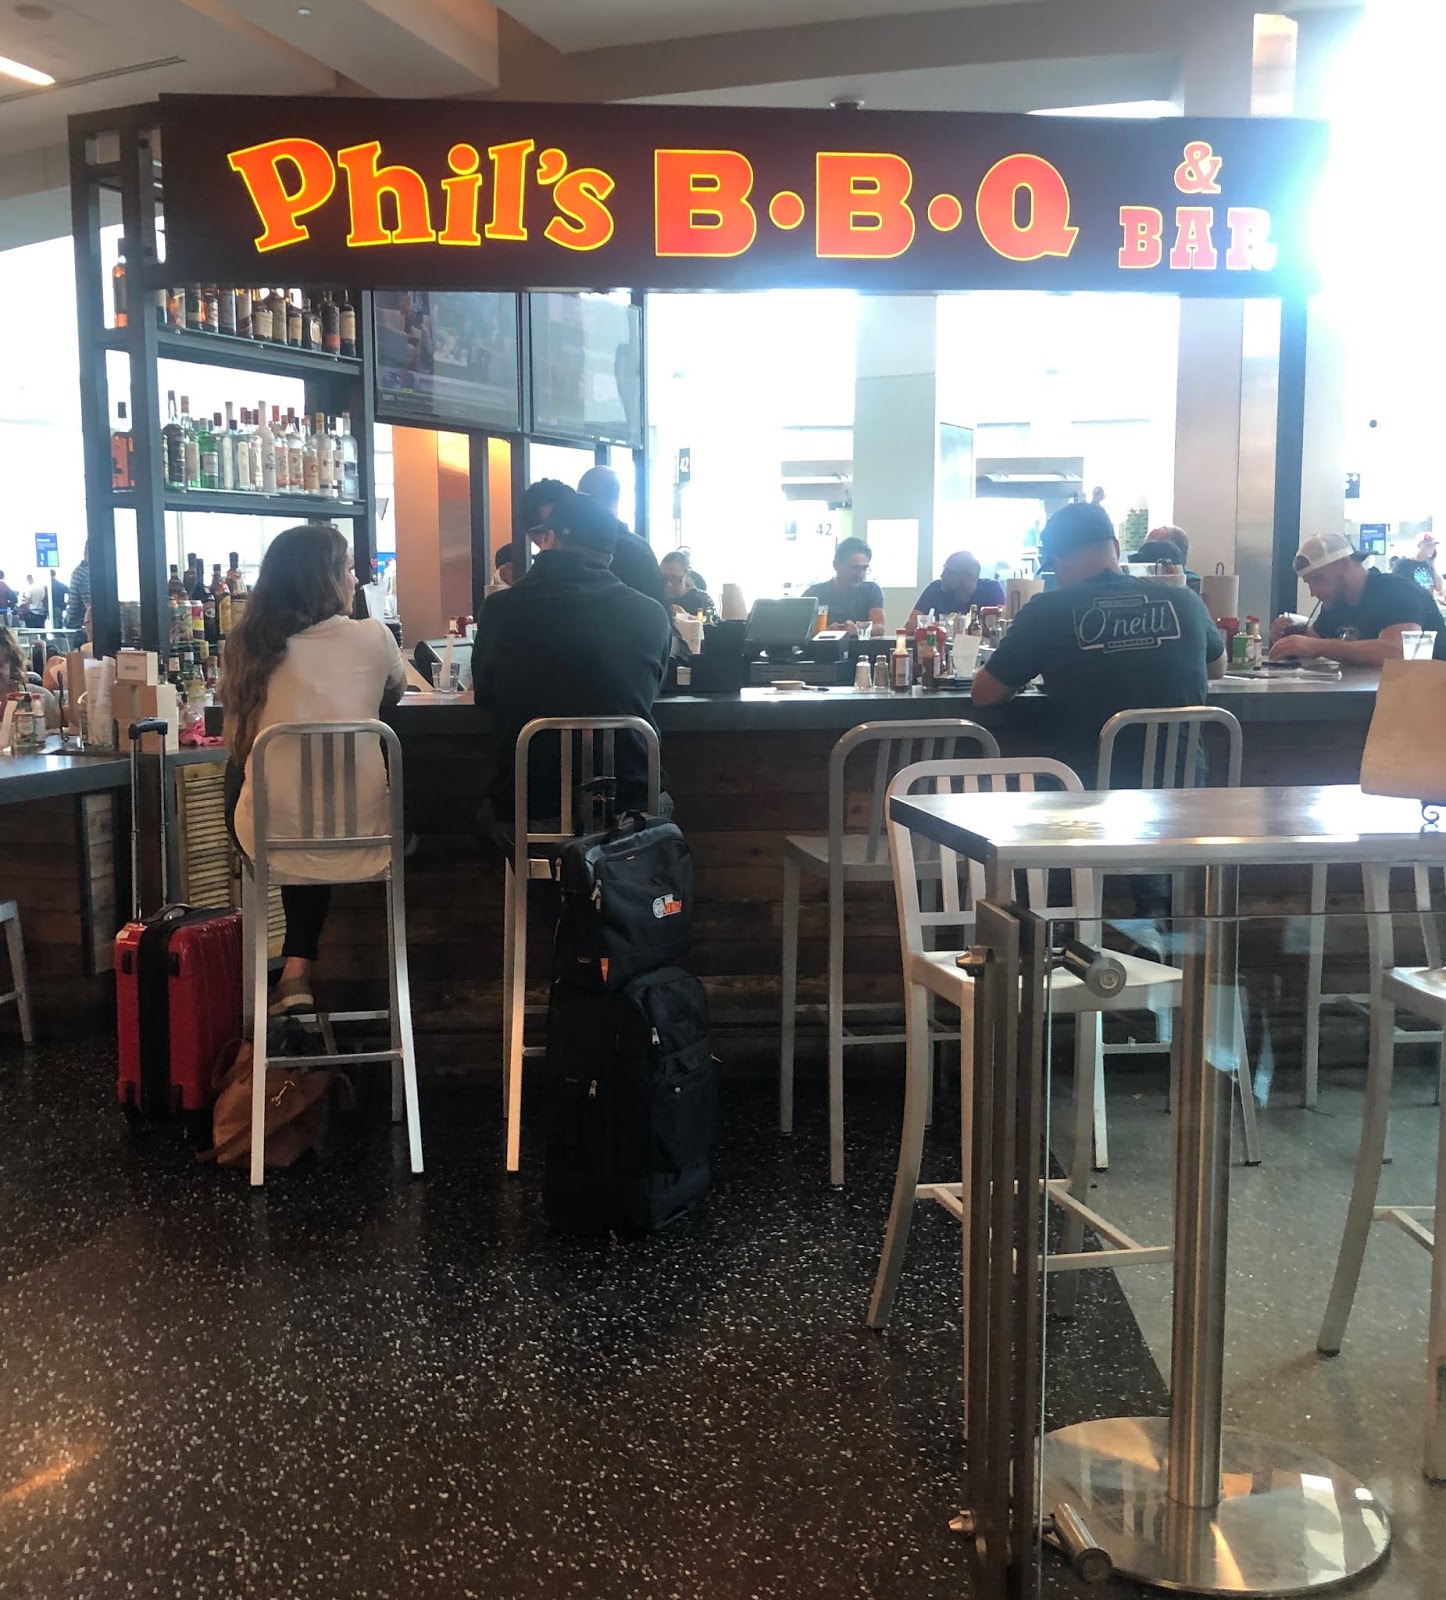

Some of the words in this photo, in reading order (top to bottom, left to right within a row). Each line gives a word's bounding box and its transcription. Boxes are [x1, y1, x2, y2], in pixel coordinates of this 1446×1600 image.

[1173, 140, 1223, 194] &
[226, 137, 616, 253] Phil's
[1118, 205, 1279, 272] BAR
[815, 523, 832, 536] 42
[1079, 606, 1172, 644] O'neill
